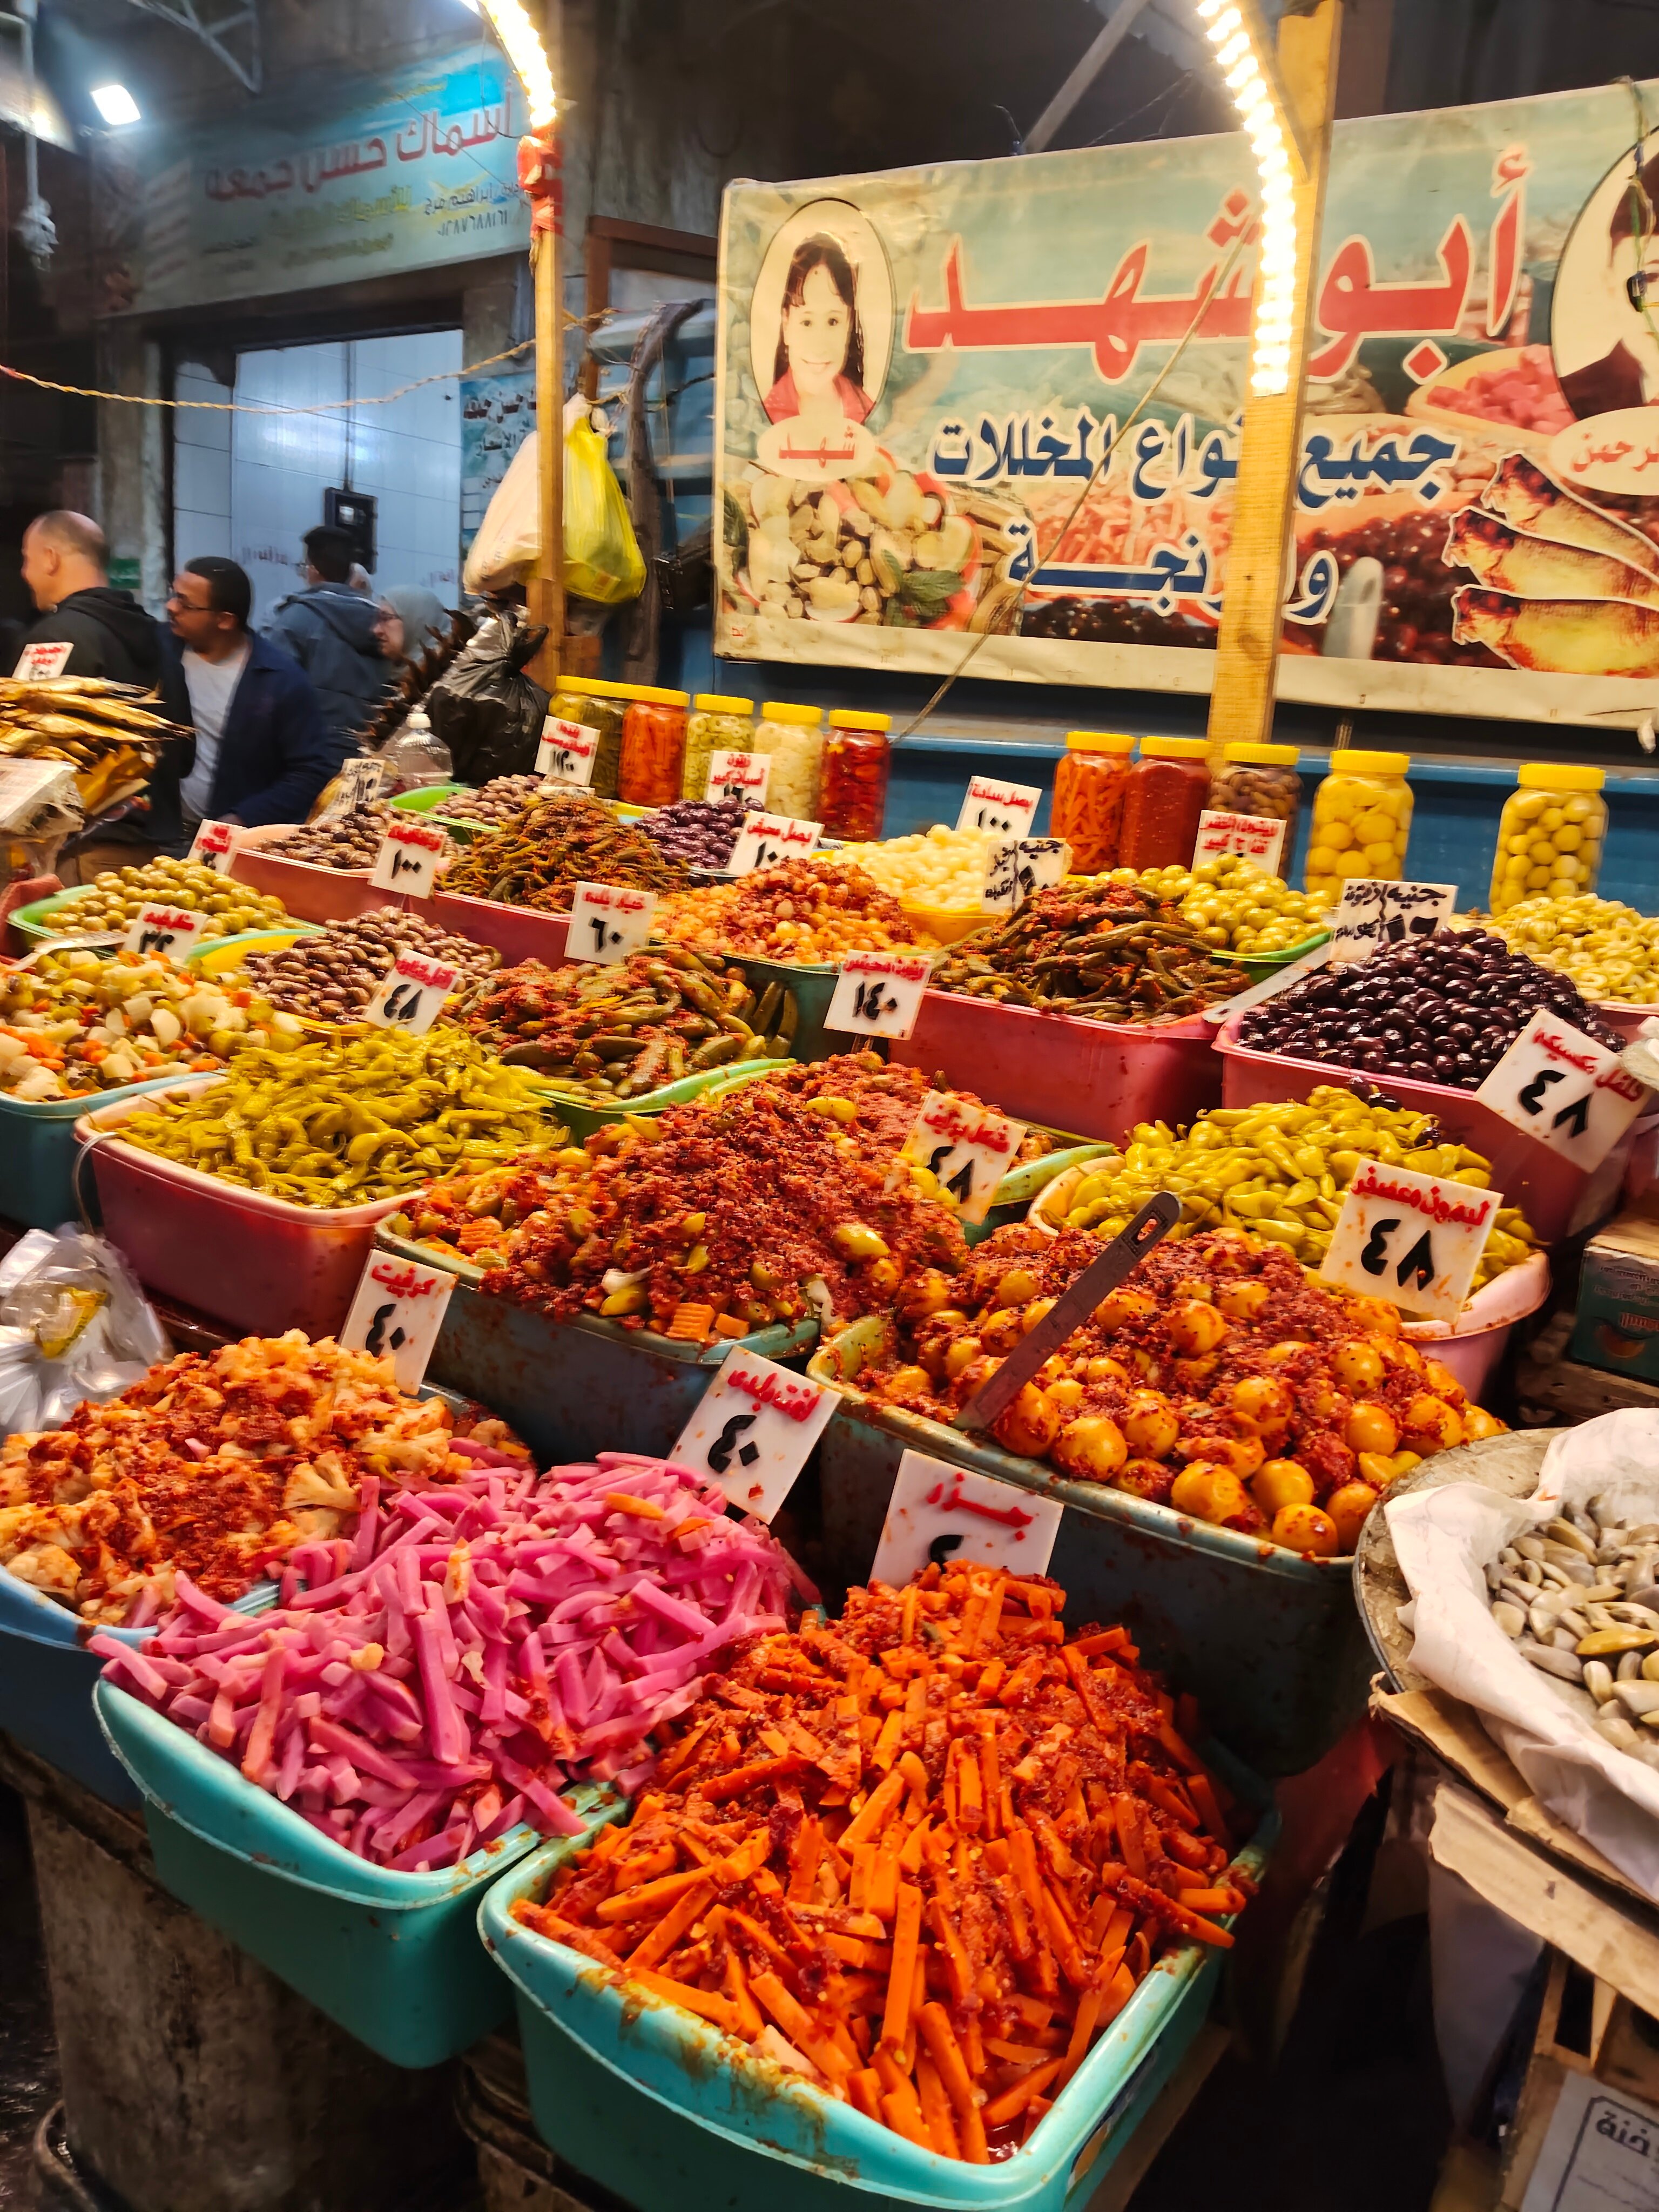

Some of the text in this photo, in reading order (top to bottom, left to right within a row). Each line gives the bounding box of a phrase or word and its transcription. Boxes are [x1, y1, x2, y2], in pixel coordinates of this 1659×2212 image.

[1310, 153, 1522, 381] أبو
[779, 425, 855, 468] شهد
[1299, 432, 1454, 505] جميع
[1573, 433, 1659, 473] رحمن
[392, 849, 422, 880] ١٠٠
[1387, 885, 1447, 909] جنيه
[588, 917, 624, 953] ٦٠
[384, 984, 423, 1021] ٤٨
[852, 981, 898, 1020] ١٤٠
[1518, 1070, 1594, 1138] ٤٨
[1420, 1186, 1490, 1234] ليمون
[1360, 1218, 1435, 1291] ٤٨
[366, 1303, 406, 1358] ٤٠
[707, 1414, 760, 1474] ٤٠
[926, 1472, 1034, 1542] جزر
